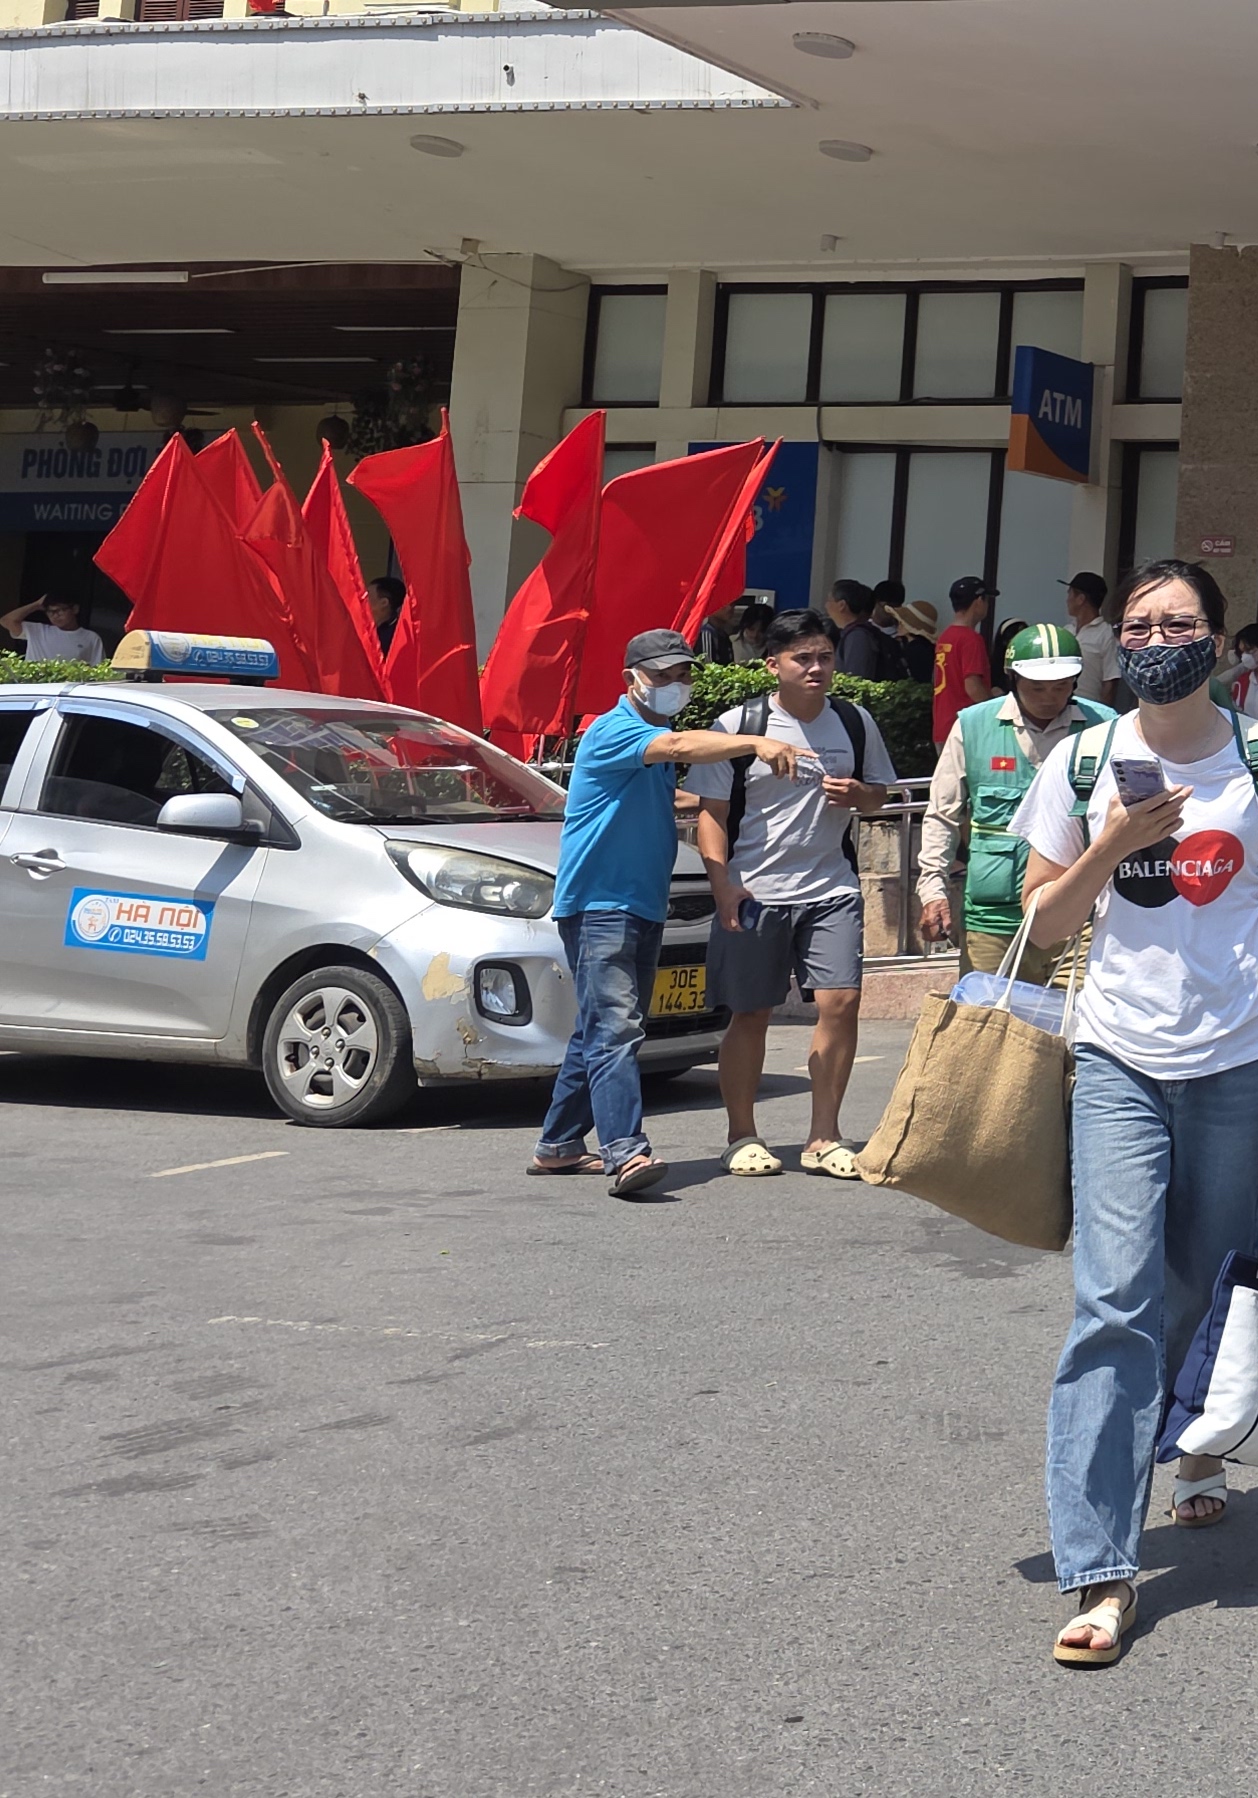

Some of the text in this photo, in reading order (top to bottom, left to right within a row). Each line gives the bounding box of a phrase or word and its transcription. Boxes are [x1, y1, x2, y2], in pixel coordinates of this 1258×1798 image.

[1038, 389, 1082, 429] ATM
[21, 441, 147, 484] PHÒNG ĐỢI
[33, 503, 113, 521] WAITING
[1118, 858, 1234, 880] BALENCIAGA
[116, 900, 200, 931] HÀ NỘI
[669, 968, 698, 990] 30E
[658, 990, 706, 1013] 144.33
